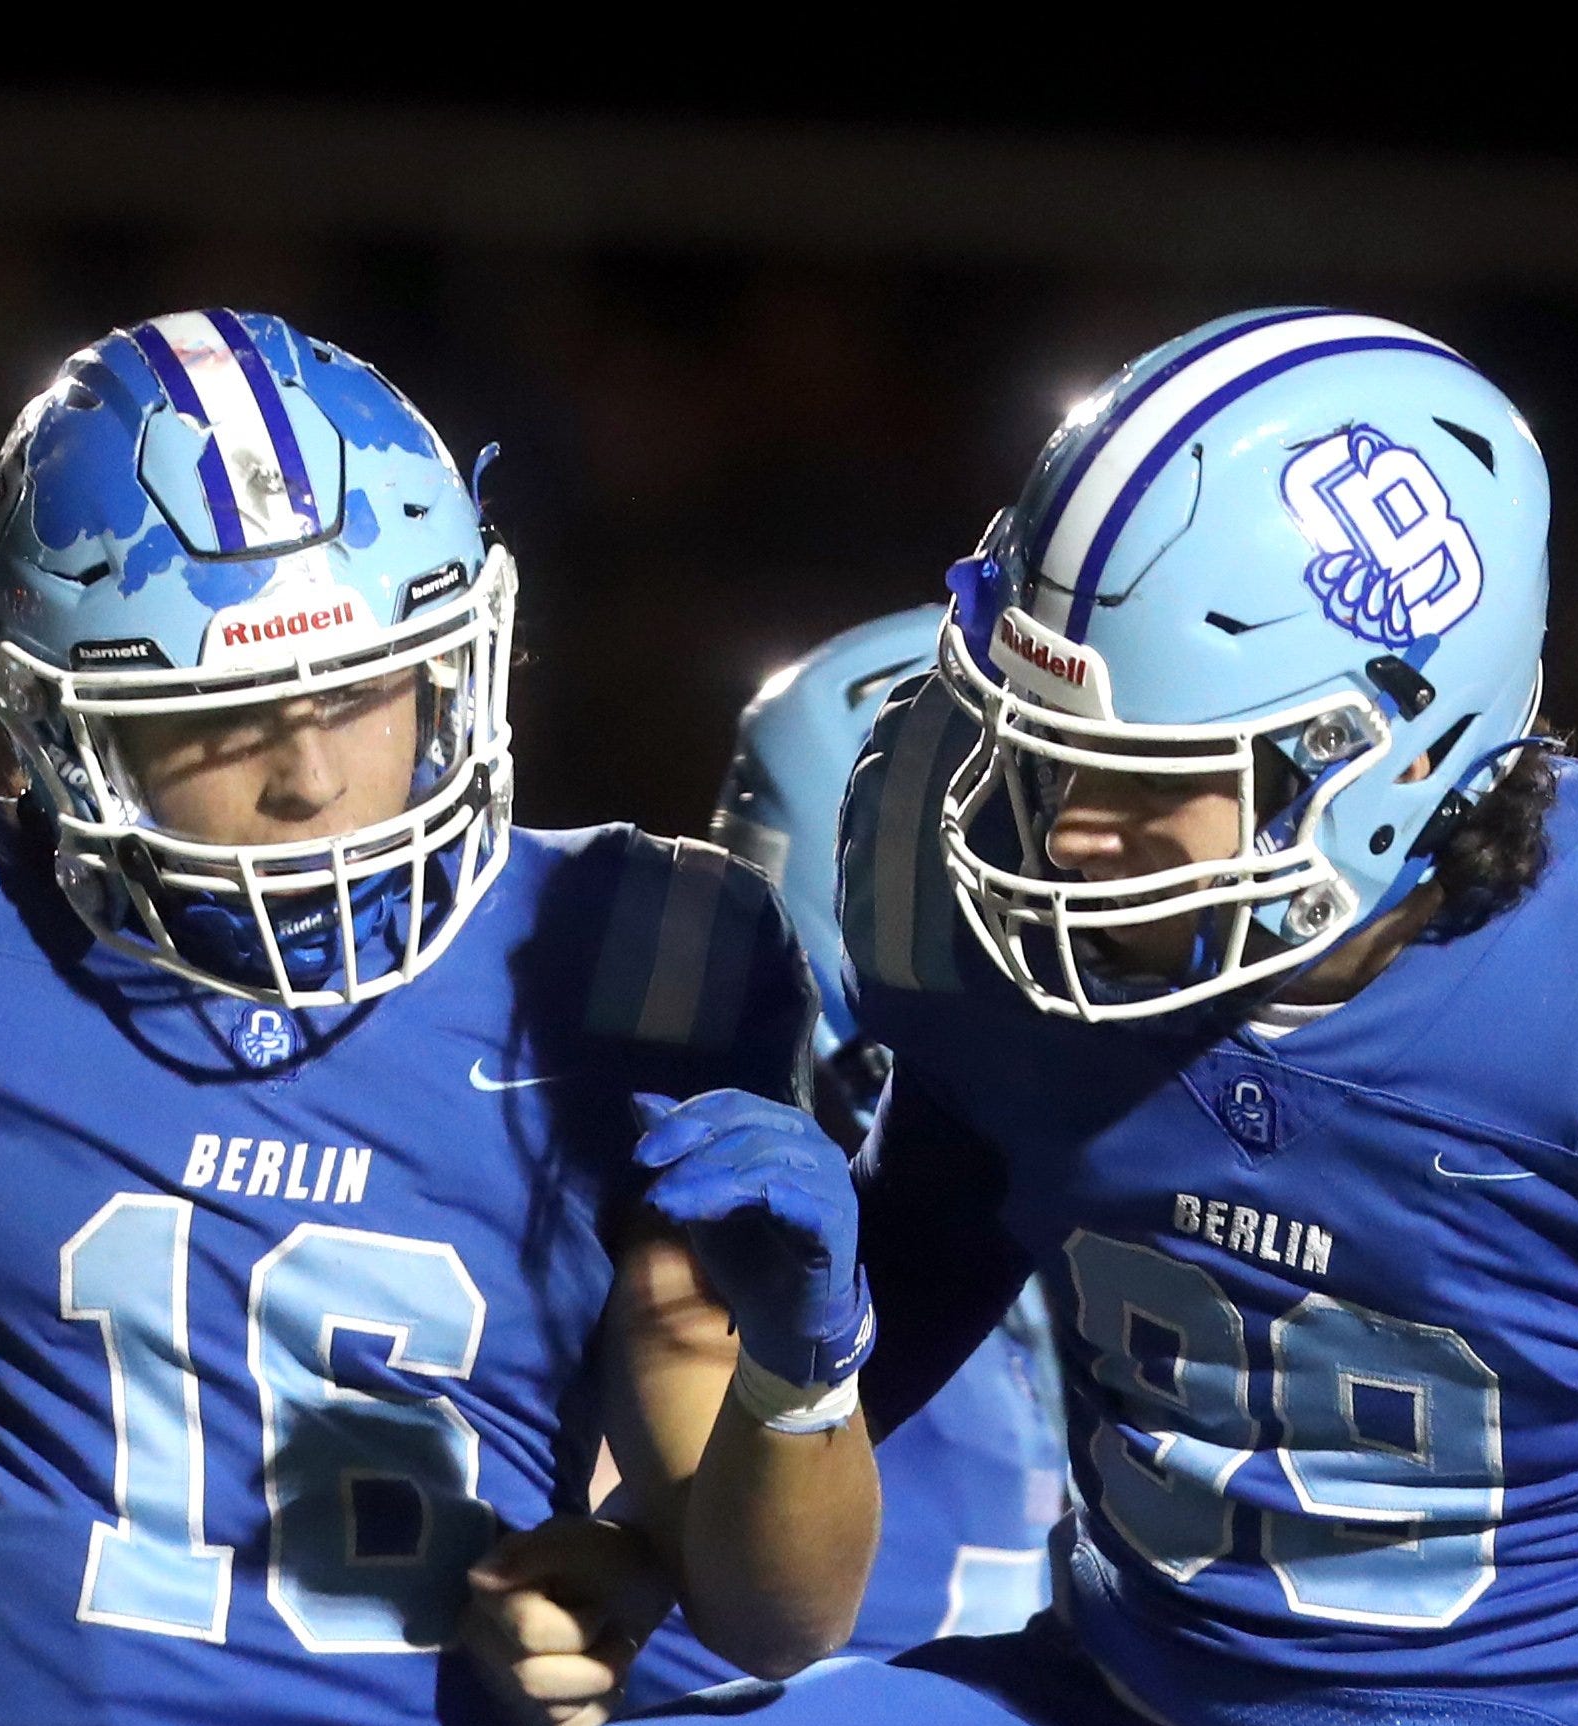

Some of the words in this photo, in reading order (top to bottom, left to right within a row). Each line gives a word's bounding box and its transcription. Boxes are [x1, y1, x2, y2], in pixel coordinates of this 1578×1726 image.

[223, 602, 354, 647] Riddell
[1001, 614, 1087, 688] Riddell
[182, 1133, 372, 1204] BERLIN
[1172, 1192, 1334, 1276] BERLIN
[59, 1191, 487, 1653] 16
[1063, 1226, 1505, 1628] 99
